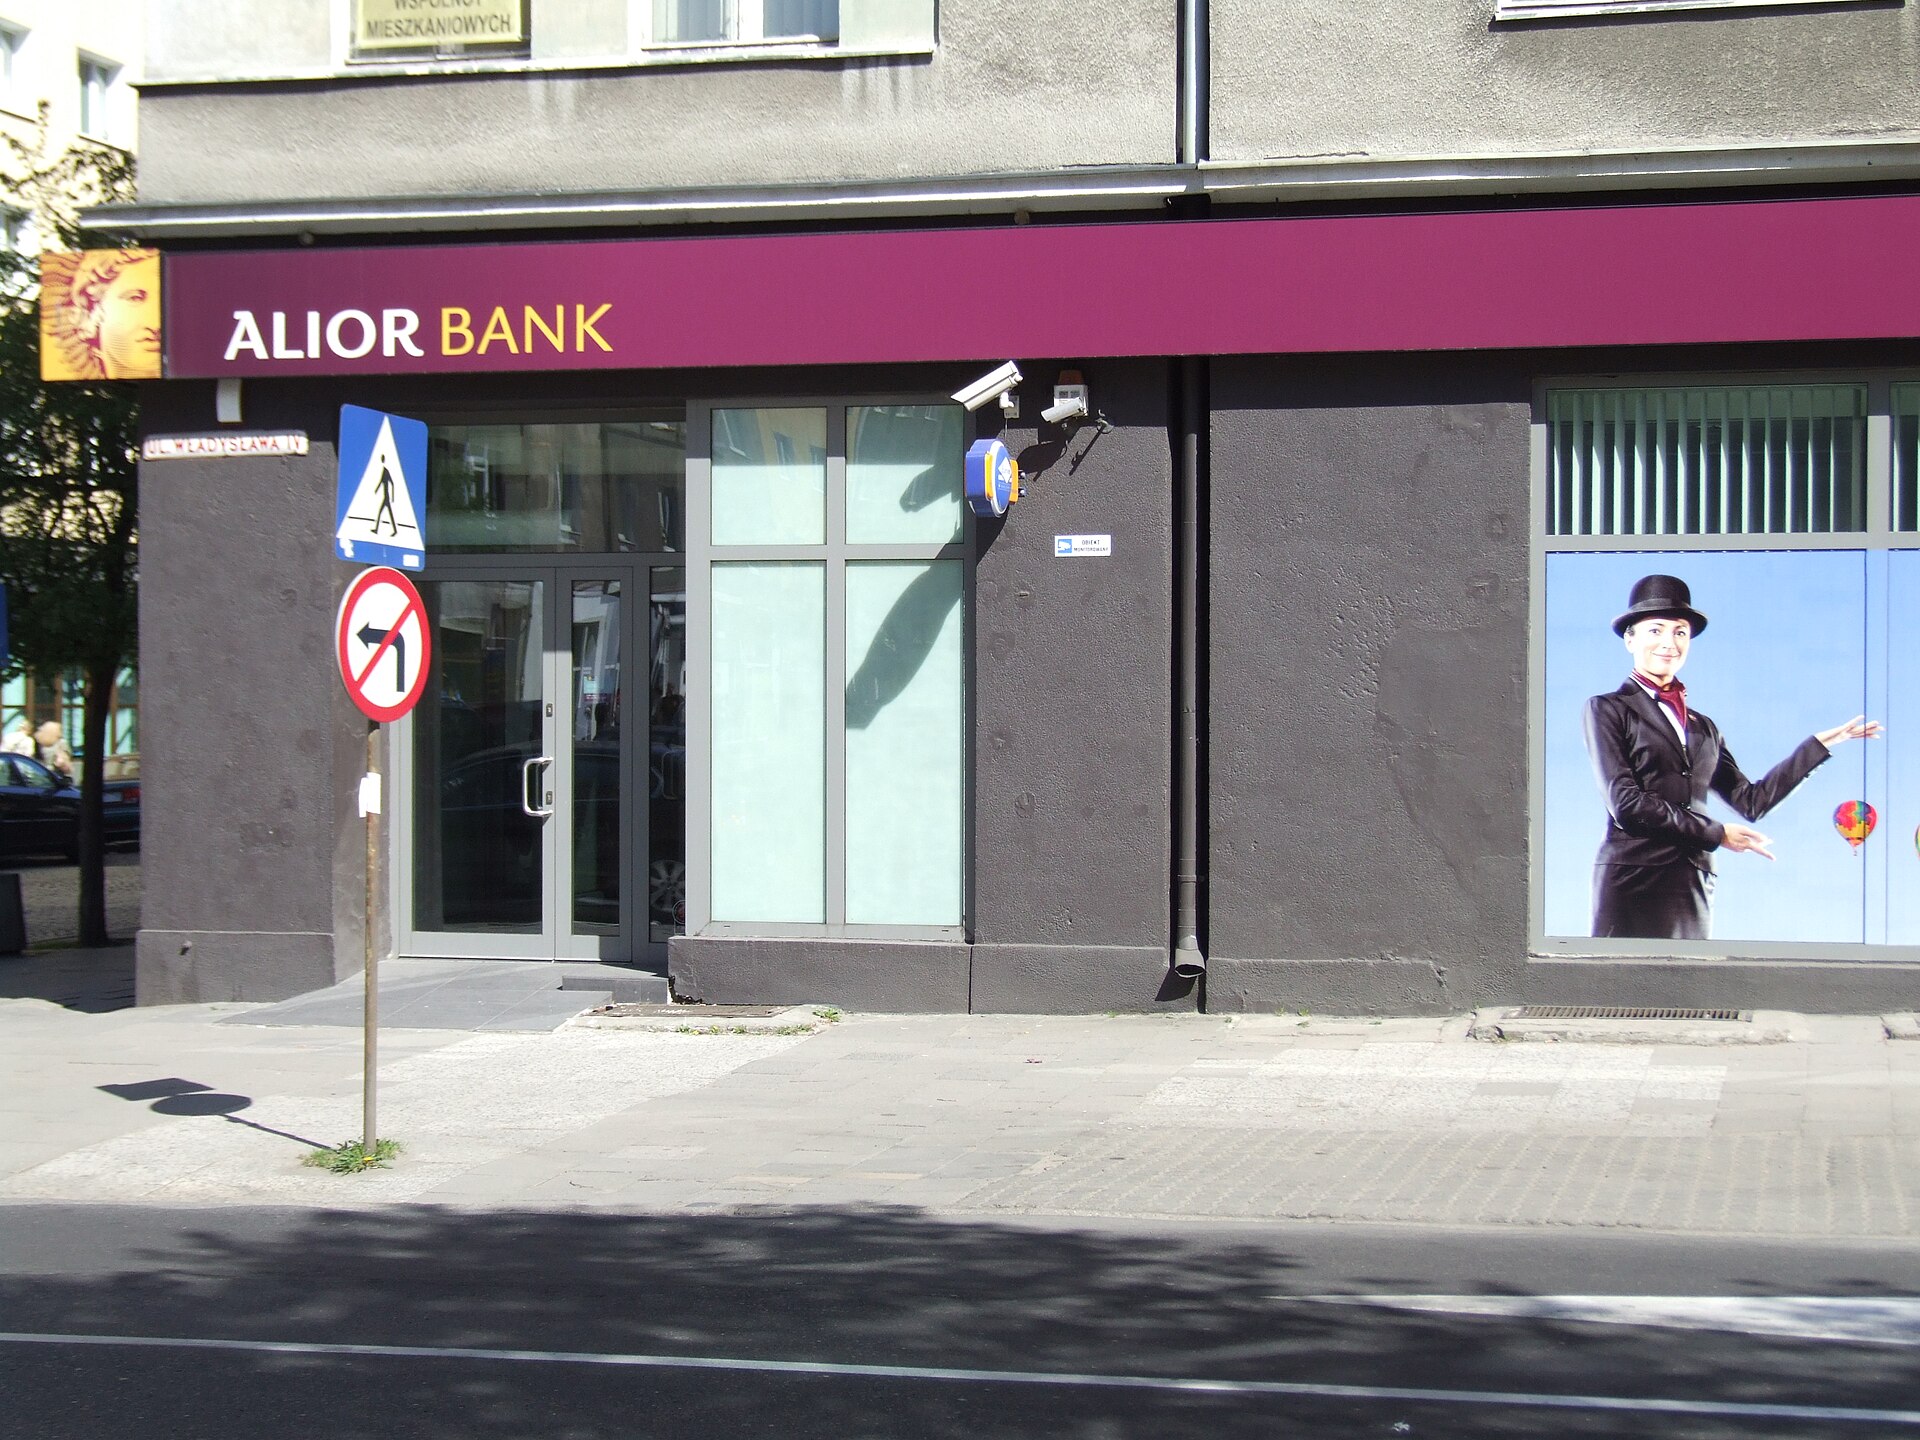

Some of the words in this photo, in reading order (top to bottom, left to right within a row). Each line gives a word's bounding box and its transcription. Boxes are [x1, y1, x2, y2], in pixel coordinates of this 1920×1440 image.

[366, 14, 511, 38] MIESZKANIOWYCH
[223, 308, 425, 361] ALIOR
[440, 303, 614, 356] BANK
[287, 435, 301, 450] IV
